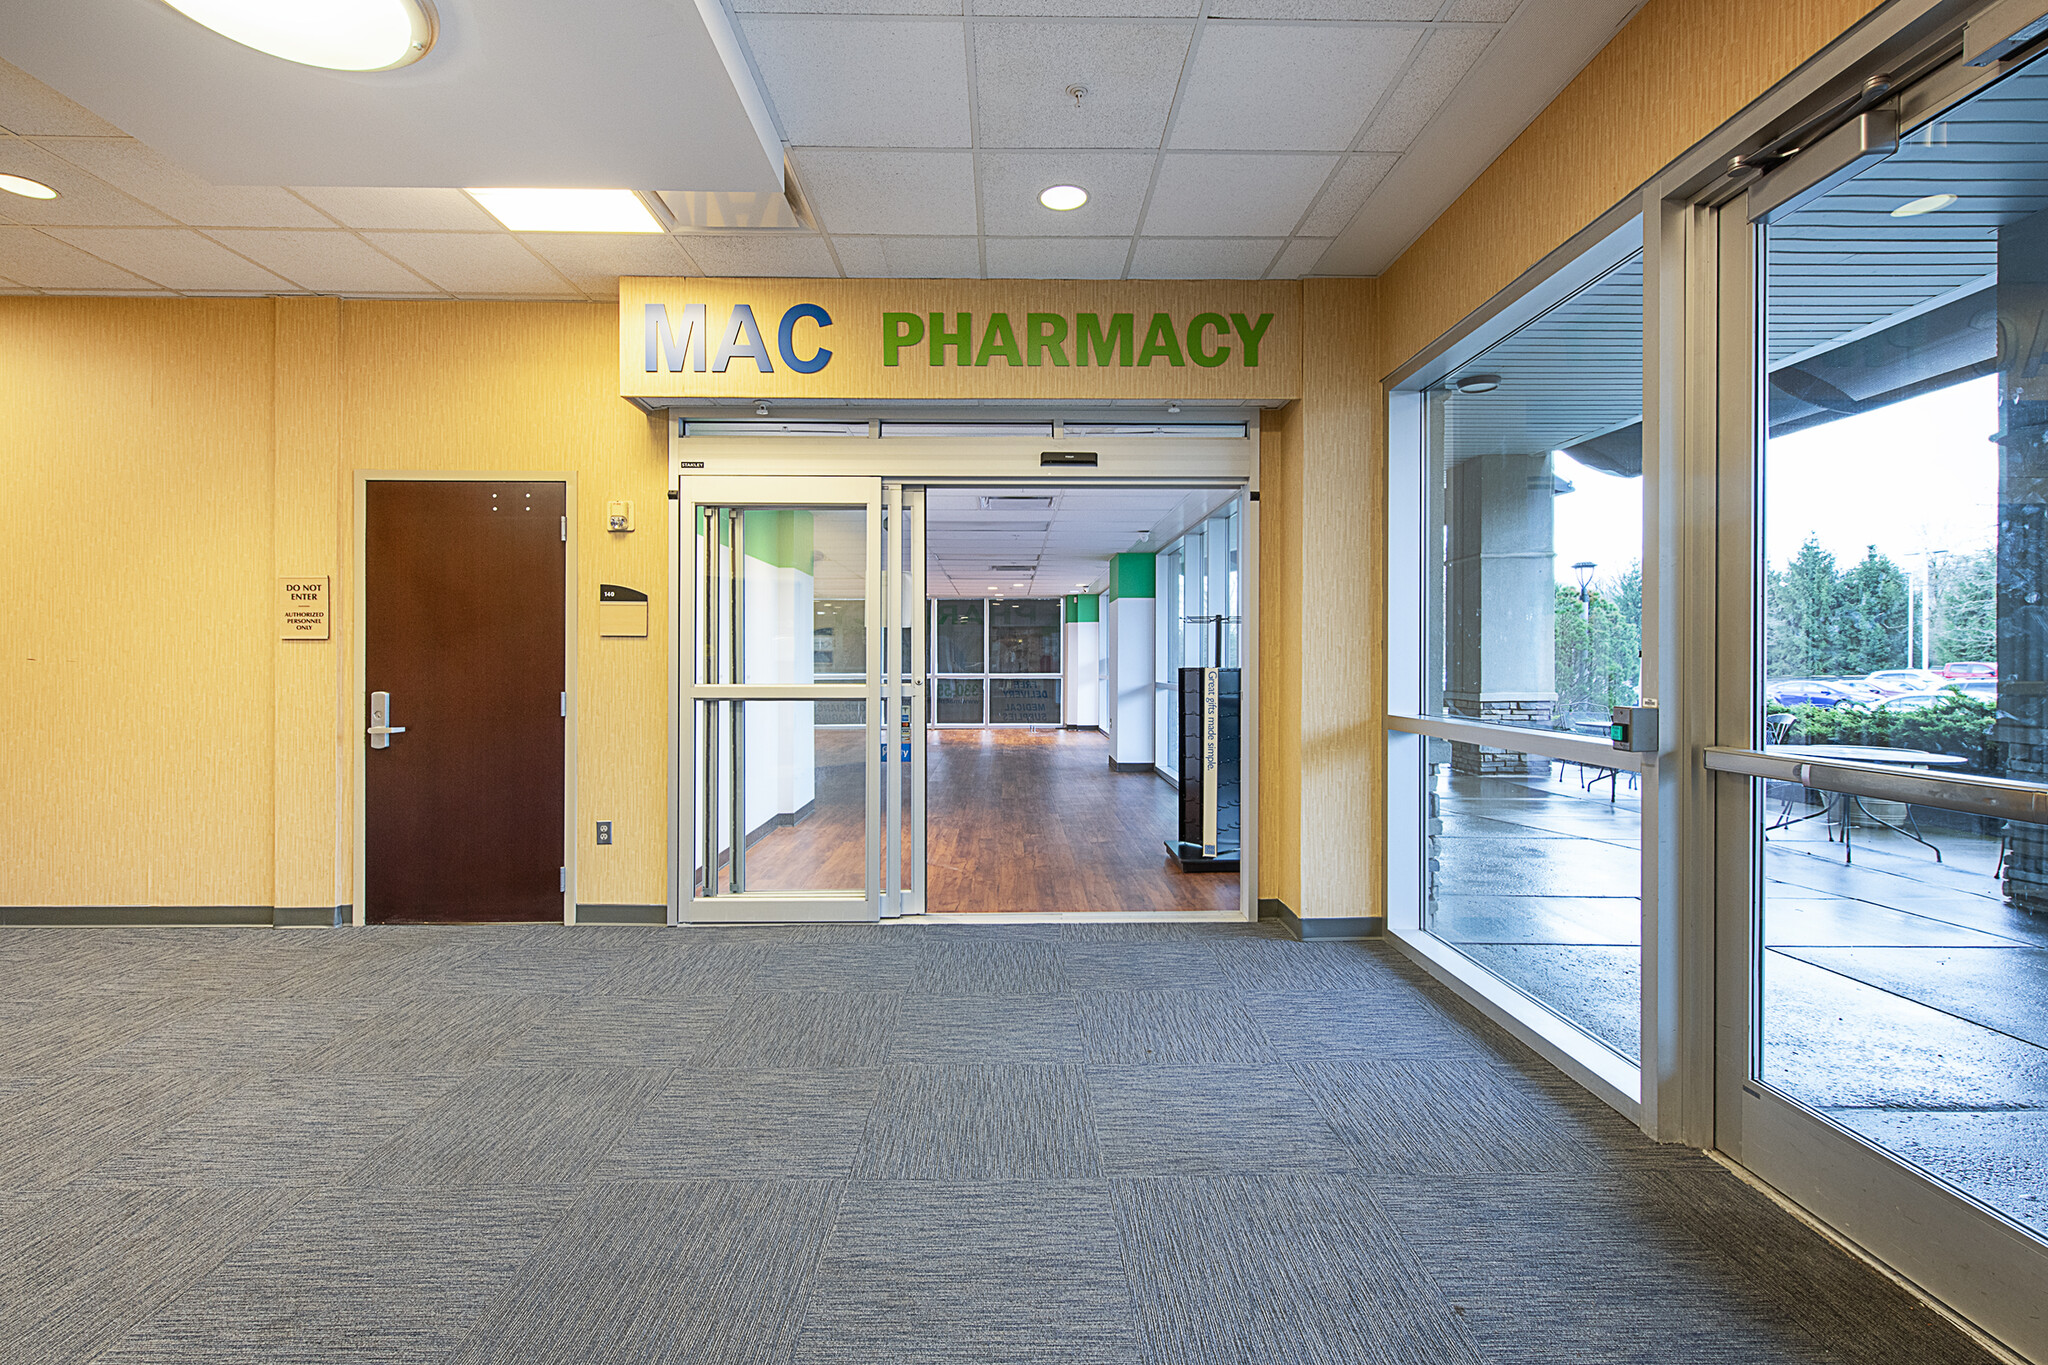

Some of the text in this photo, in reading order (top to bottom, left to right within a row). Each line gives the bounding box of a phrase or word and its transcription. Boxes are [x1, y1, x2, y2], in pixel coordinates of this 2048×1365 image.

[644, 303, 1274, 374] MAC PHARMACY
[1208, 671, 1217, 695] Great
[1205, 697, 1217, 715] gifts
[1207, 717, 1217, 740] made
